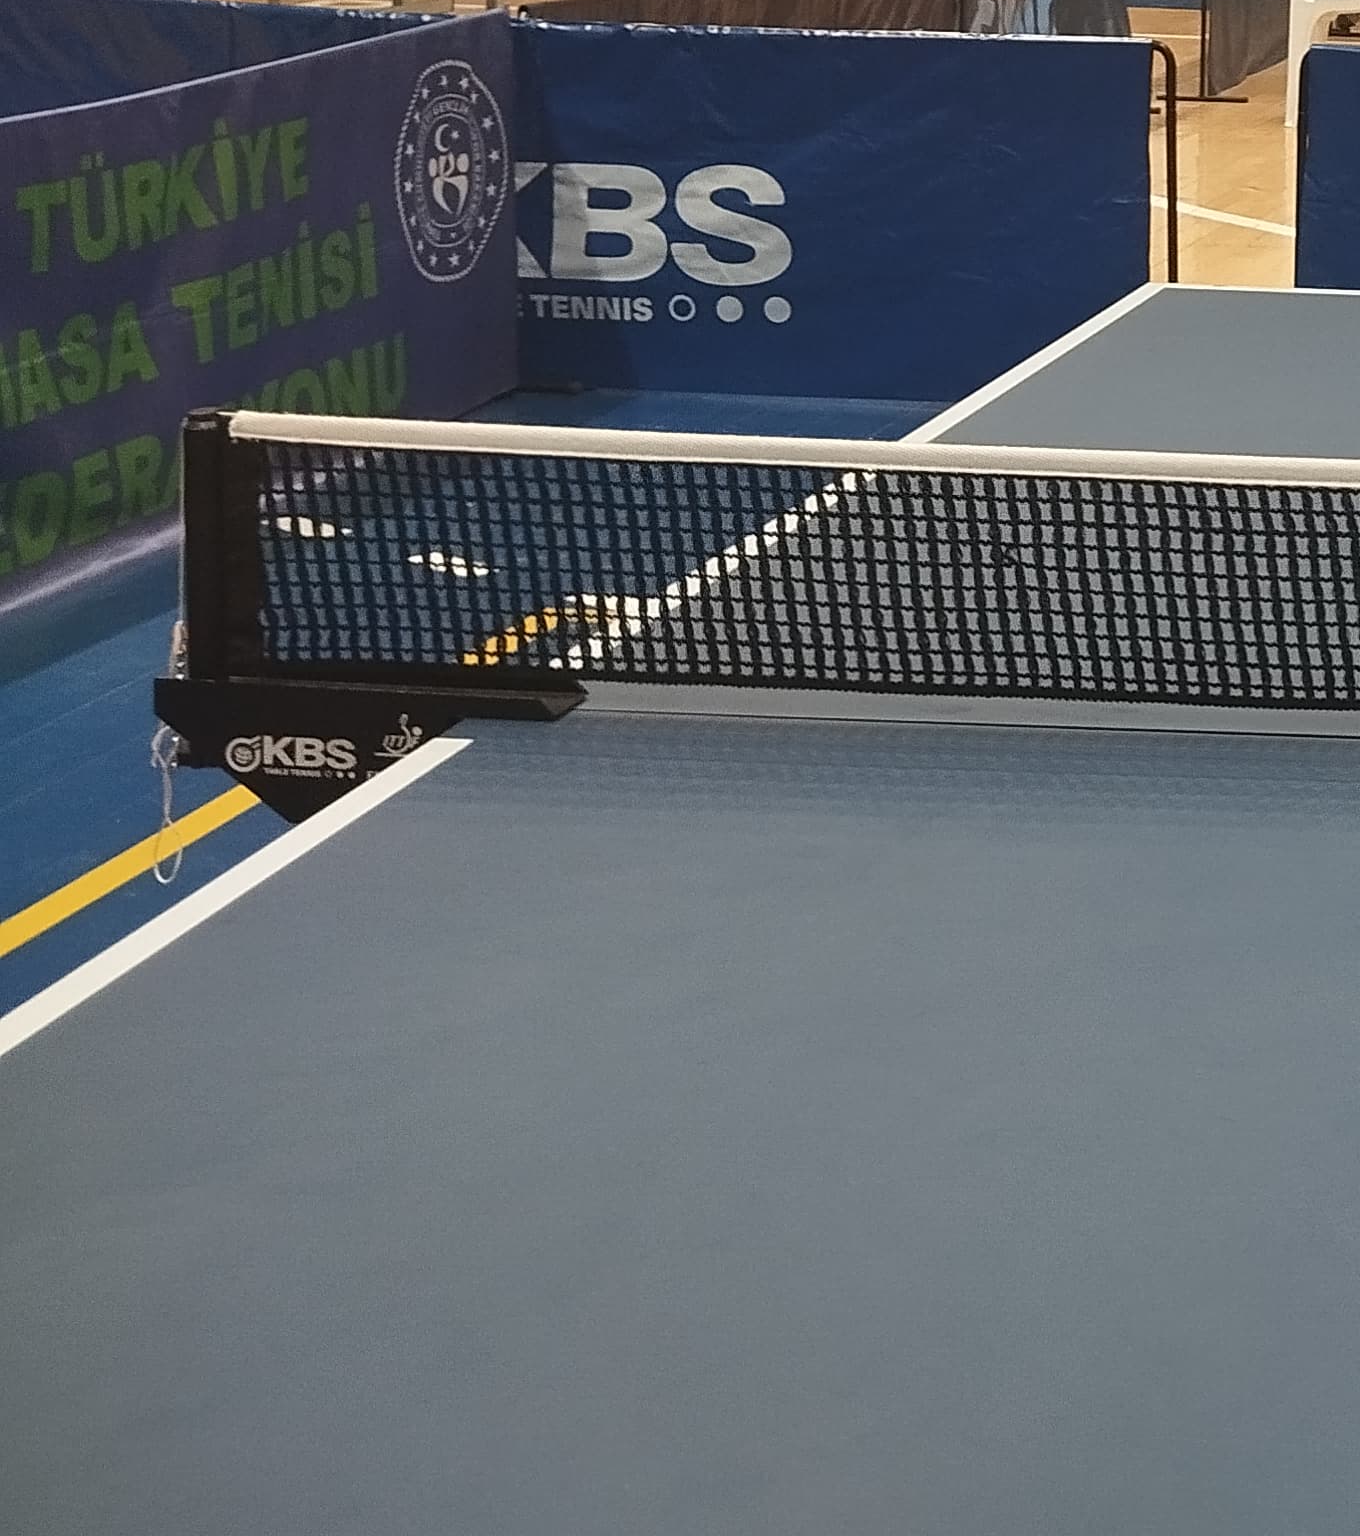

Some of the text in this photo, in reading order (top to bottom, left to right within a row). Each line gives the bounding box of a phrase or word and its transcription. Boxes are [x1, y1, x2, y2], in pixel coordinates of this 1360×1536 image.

[15, 119, 310, 273] TÜRKİYE
[514, 162, 792, 286] BS
[171, 202, 378, 363] TENİSİ
[529, 293, 653, 323] TENNIS
[262, 736, 358, 770] KBS
